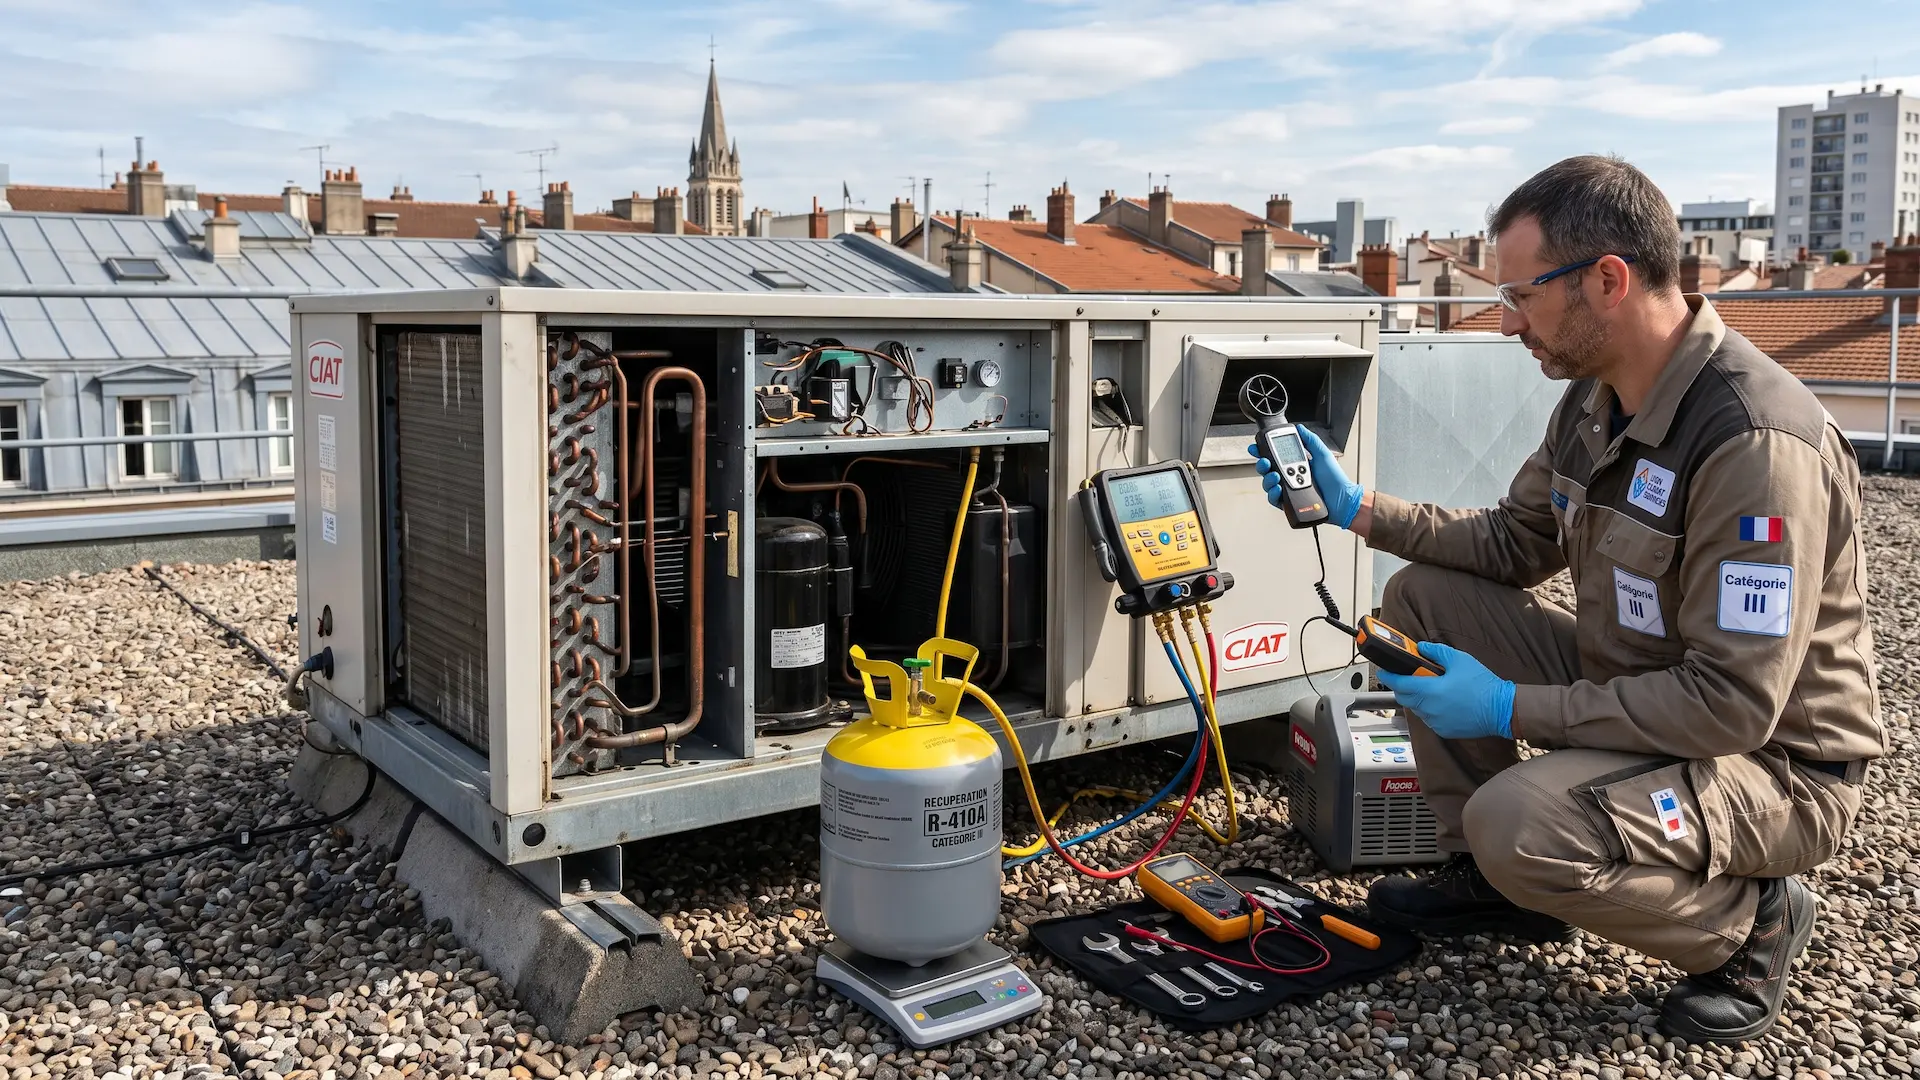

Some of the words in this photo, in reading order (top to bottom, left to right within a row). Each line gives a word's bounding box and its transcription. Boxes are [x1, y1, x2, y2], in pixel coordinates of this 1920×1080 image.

[310, 356, 342, 385] CIAT
[1617, 580, 1654, 601] Catégorie
[1725, 574, 1787, 592] Catégorie
[1629, 599, 1644, 619] III
[1744, 593, 1766, 614] III
[1225, 633, 1287, 661] CIAT
[924, 787, 988, 808] RECUPERATION
[928, 805, 985, 832] R-410A
[932, 831, 976, 848] CATEGORIE
